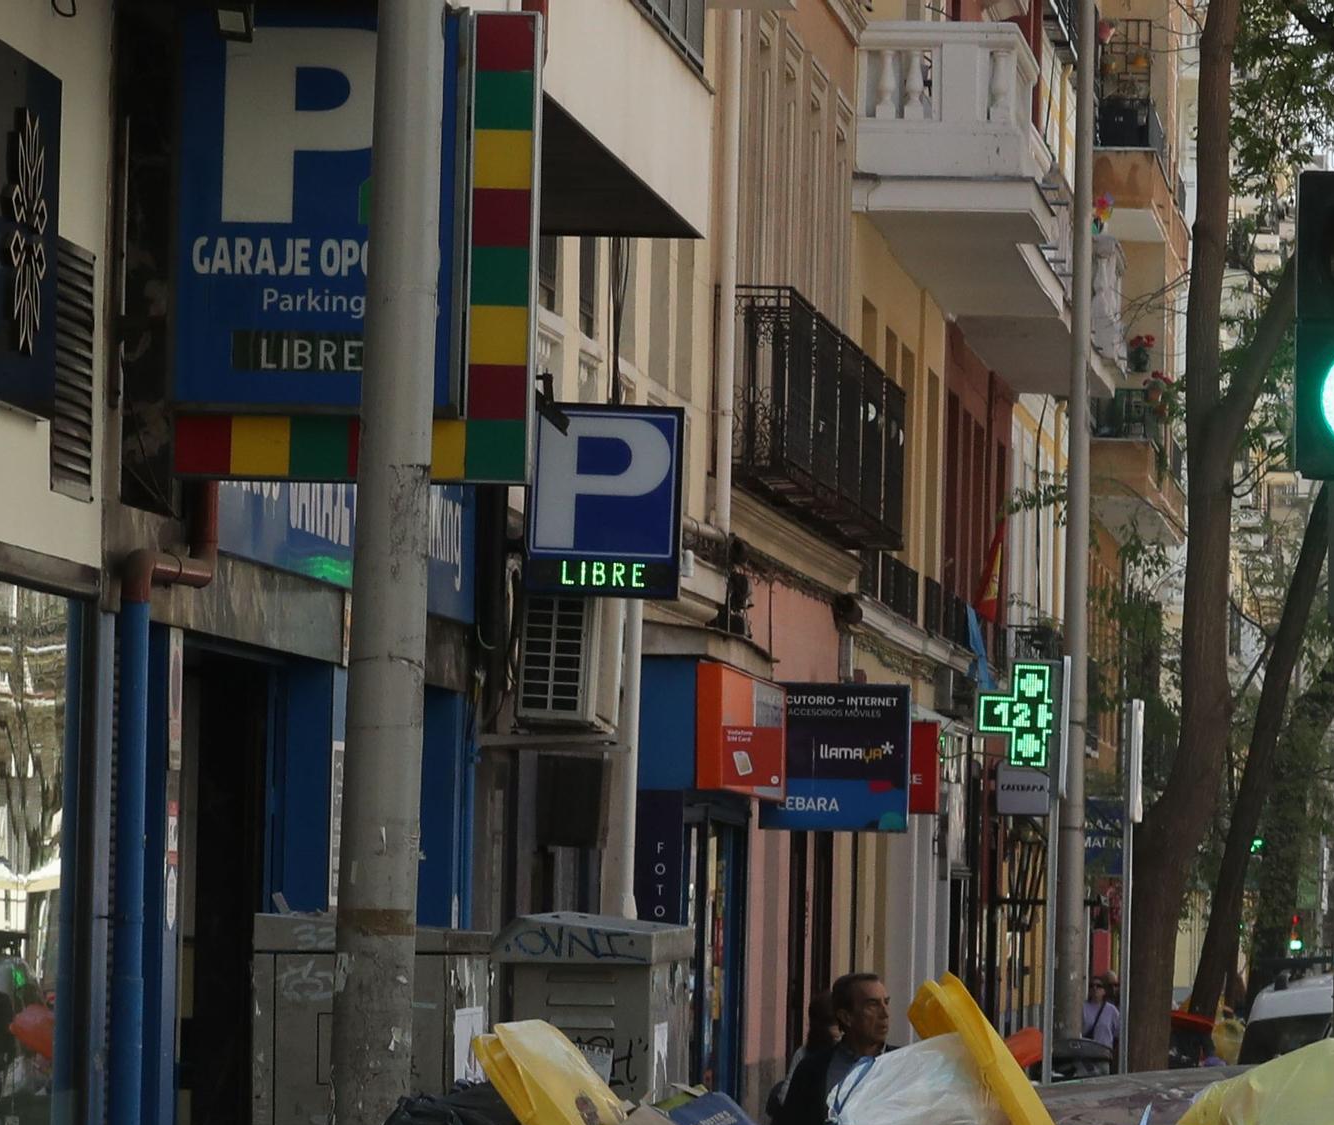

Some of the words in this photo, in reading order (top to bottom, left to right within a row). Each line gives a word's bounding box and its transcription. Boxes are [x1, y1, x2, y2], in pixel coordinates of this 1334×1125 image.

[192, 236, 311, 277] GARAJE
[263, 288, 365, 318] Parking
[259, 337, 364, 371] LIBRE
[560, 559, 647, 589] LIBRE
[785, 695, 836, 706] CUTORIO
[846, 695, 899, 707] INTERNET
[653, 841, 666, 918] FOTO
